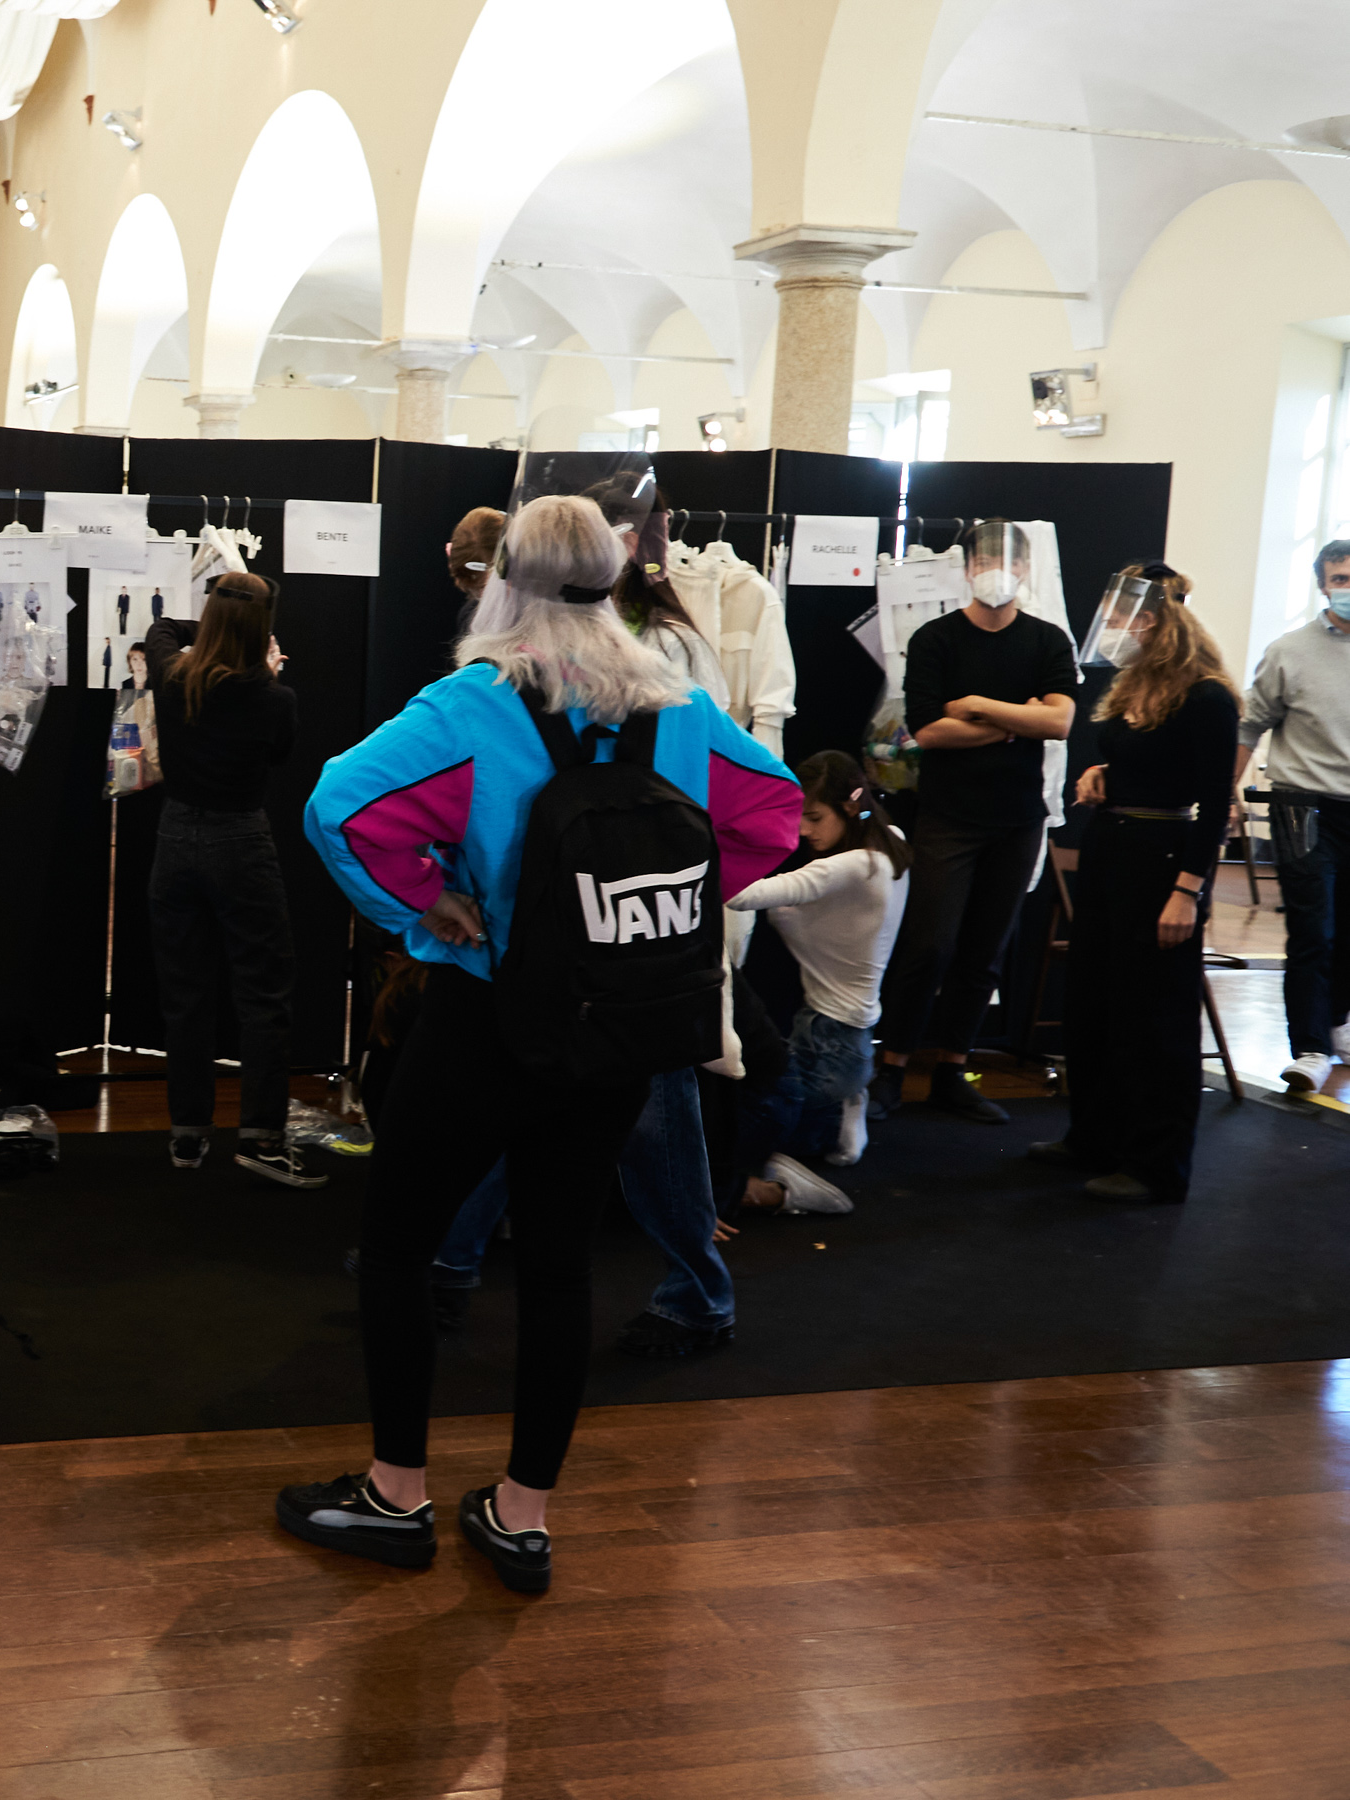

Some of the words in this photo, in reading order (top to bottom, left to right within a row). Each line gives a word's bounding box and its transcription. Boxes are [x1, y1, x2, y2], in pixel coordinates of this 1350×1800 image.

[78, 525, 113, 535] MAIKE
[316, 532, 349, 542] BENTE
[812, 545, 858, 555] RACHELLE
[575, 859, 710, 944] VANS
